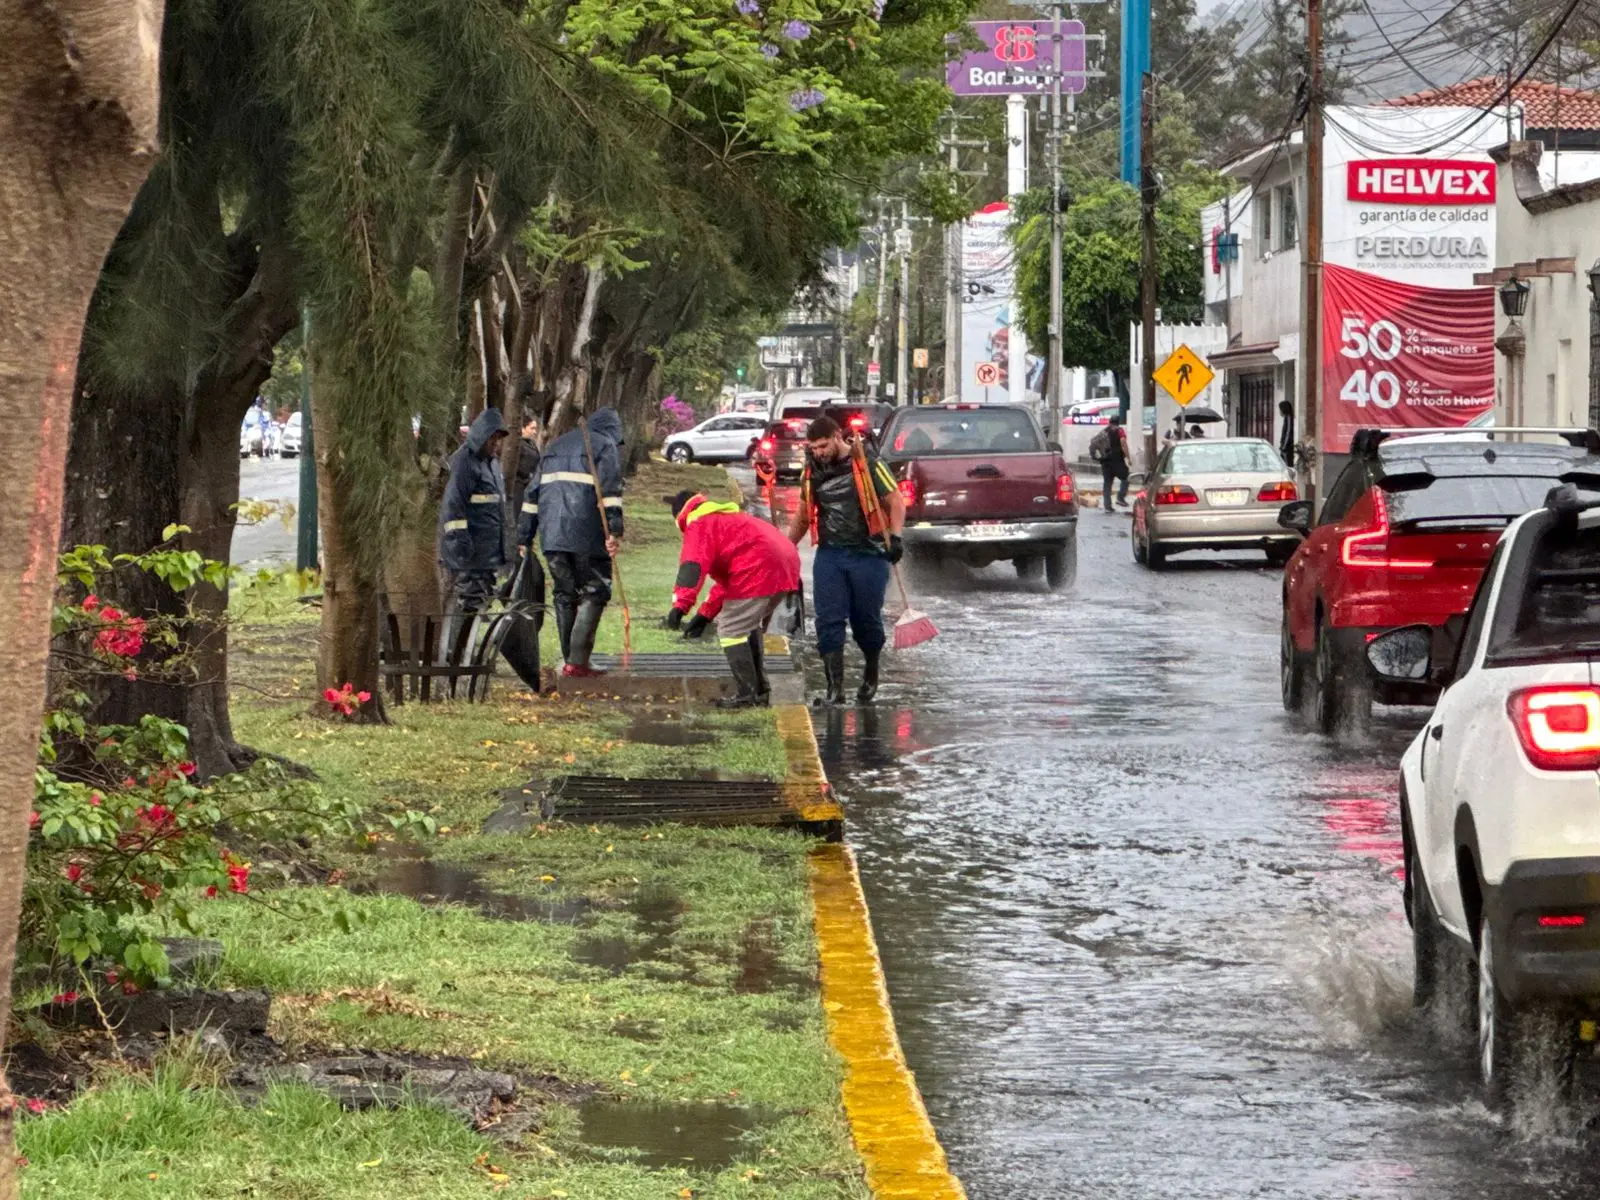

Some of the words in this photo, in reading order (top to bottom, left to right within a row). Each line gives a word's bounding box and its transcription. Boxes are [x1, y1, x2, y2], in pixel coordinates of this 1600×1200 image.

[1357, 167, 1491, 195] HELVEX
[1359, 208, 1416, 225] garantía
[1419, 208, 1437, 222] de
[1439, 207, 1489, 222] calidad
[1355, 236, 1488, 259] PERDURA
[1405, 345, 1420, 354] en
[1422, 344, 1478, 356] paquetes
[1406, 397, 1421, 406] en
[1423, 395, 1452, 406] todo
